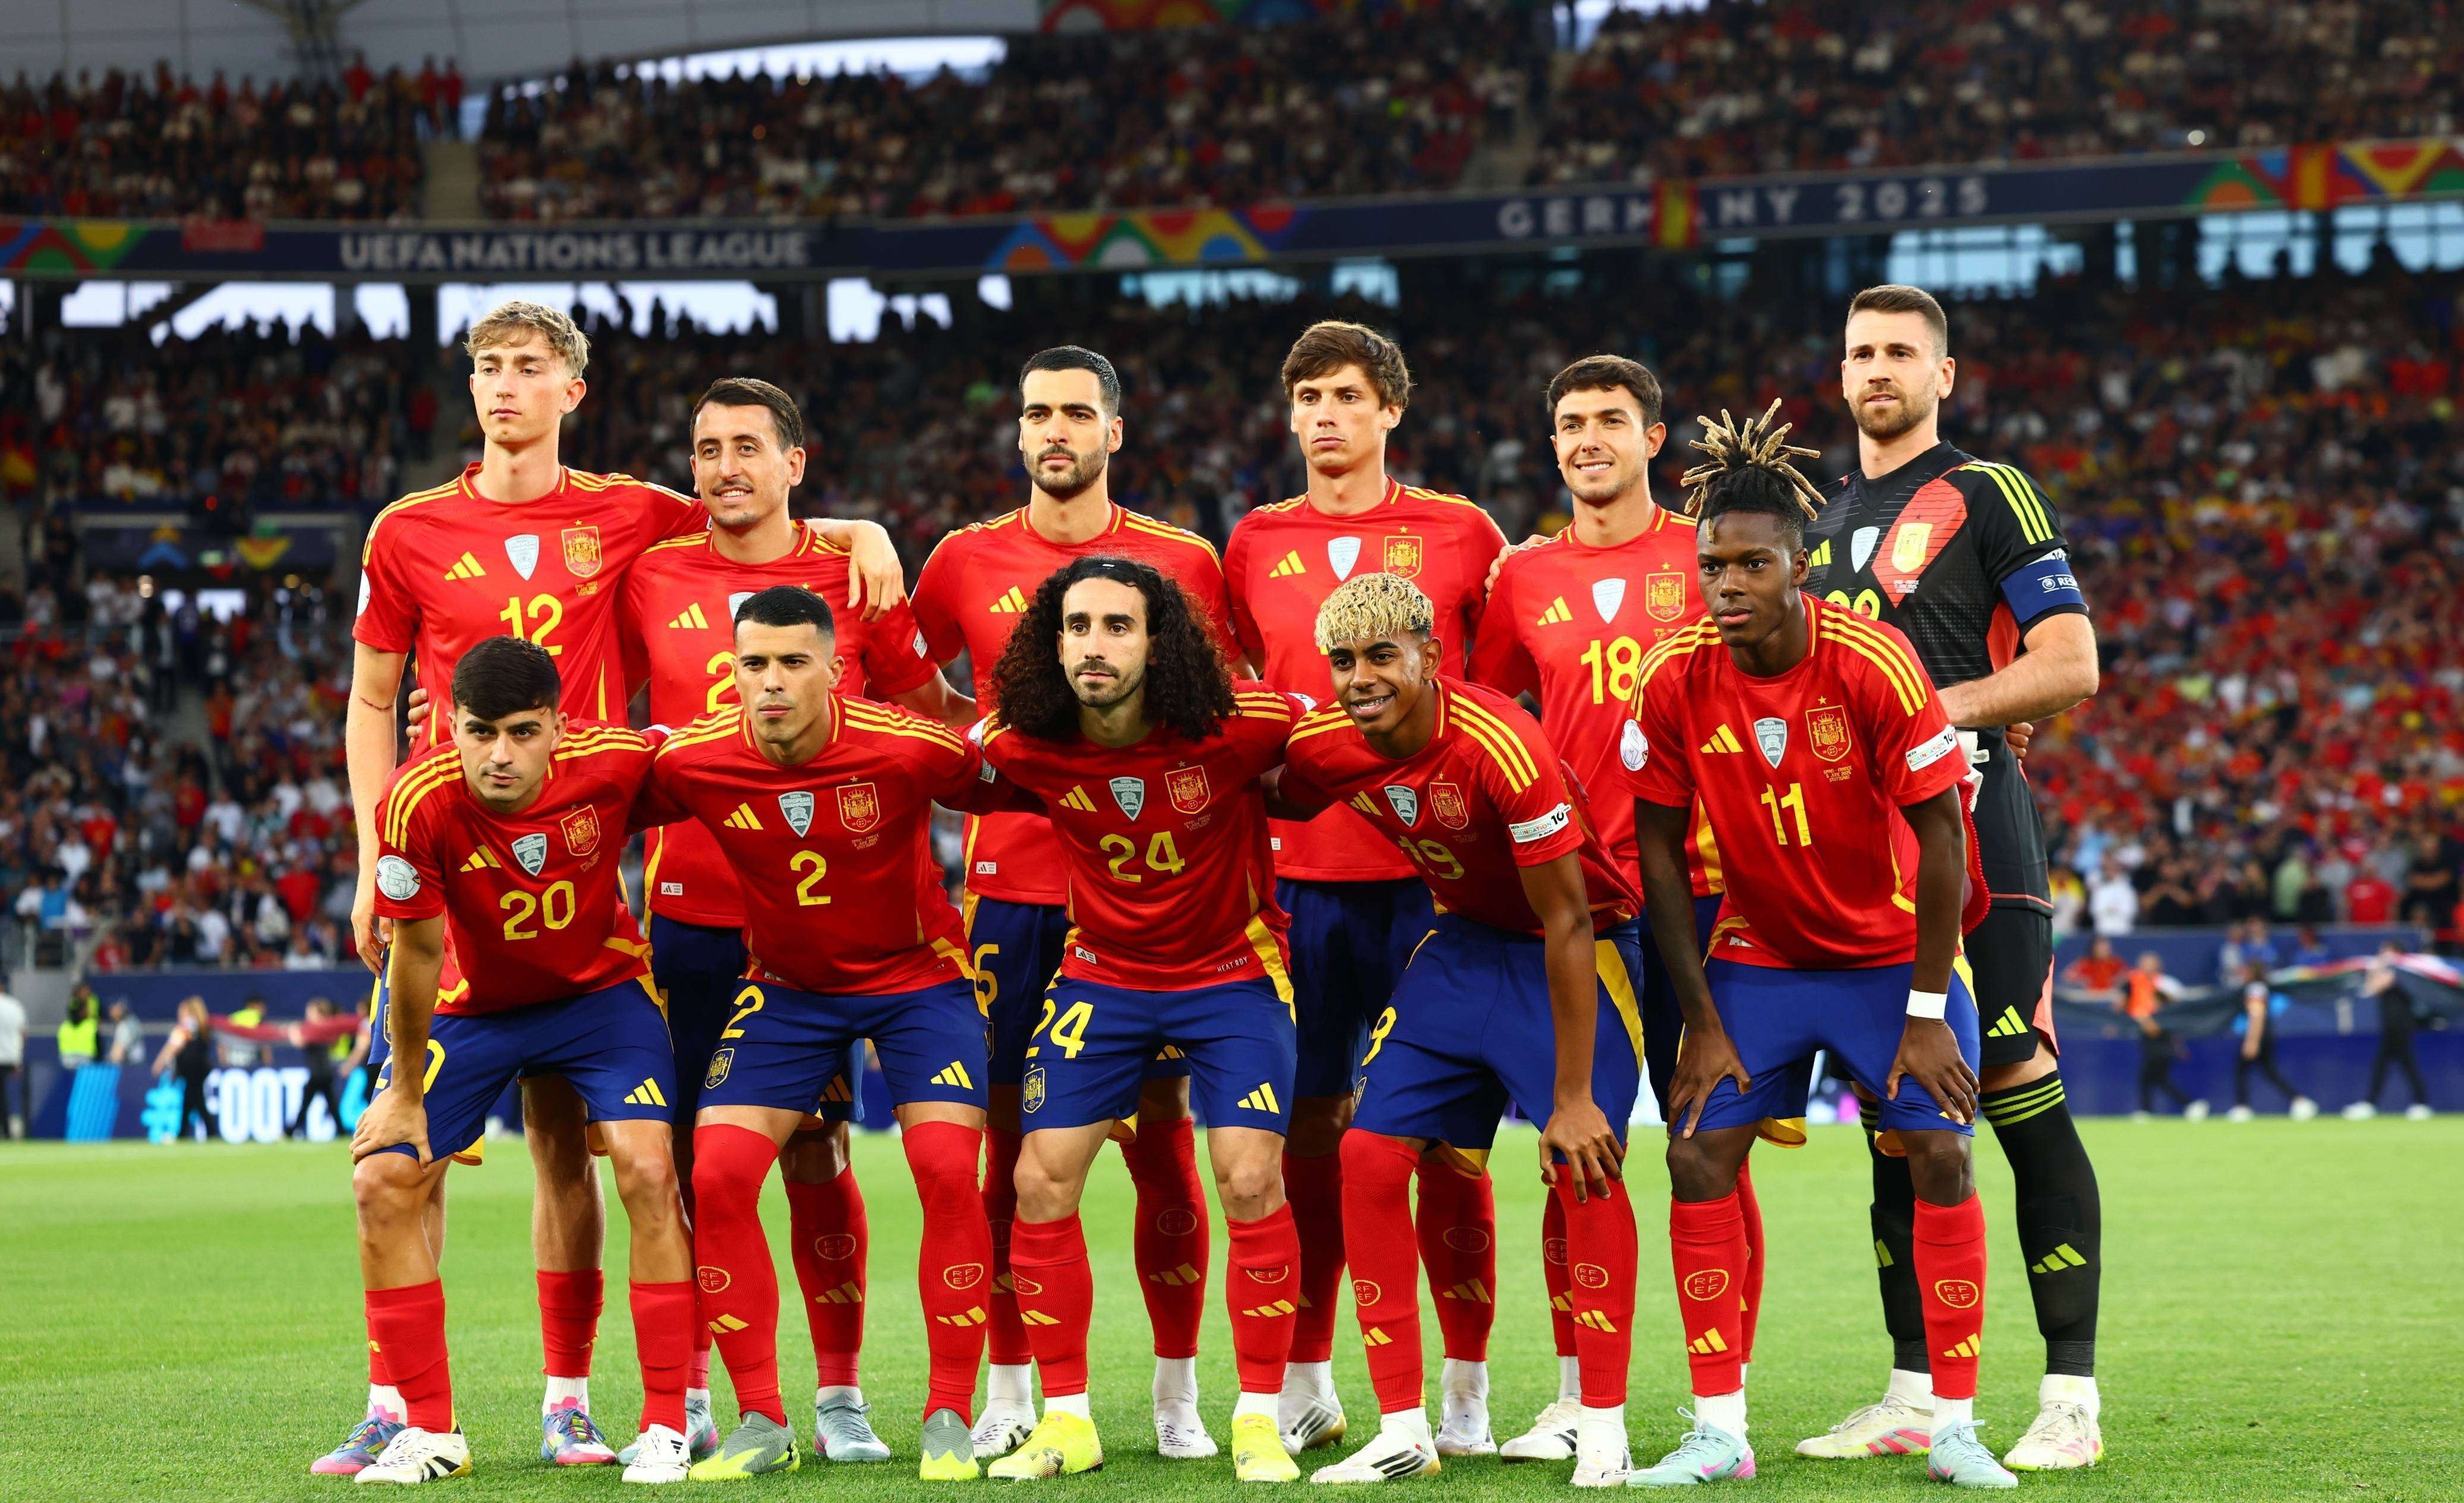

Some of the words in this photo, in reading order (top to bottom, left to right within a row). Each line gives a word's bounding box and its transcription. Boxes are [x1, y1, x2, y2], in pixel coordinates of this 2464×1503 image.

[1496, 189, 1800, 238] GERMNY
[1836, 177, 1989, 219] 2025
[340, 234, 443, 270] UEFA
[453, 233, 639, 269] NATIONS
[645, 232, 810, 268] LEAGUE
[500, 594, 563, 656] 12
[706, 651, 740, 714] 2
[1580, 636, 1641, 704] 18
[1512, 820, 1553, 836] FOUNDATION
[1551, 811, 1564, 825] 10
[1761, 783, 1812, 846] 11
[790, 850, 831, 906] 2
[1099, 831, 1185, 883] 24
[1397, 835, 1465, 880] 19
[499, 880, 575, 941] 20
[1217, 956, 1247, 973] HEAT.RDY
[720, 985, 764, 1039] 2
[1025, 998, 1094, 1058] 24
[953, 1268, 975, 1277] RF
[953, 1274, 975, 1284] EF
[1694, 1275, 1719, 1285] RF
[1694, 1284, 1718, 1294] EF
